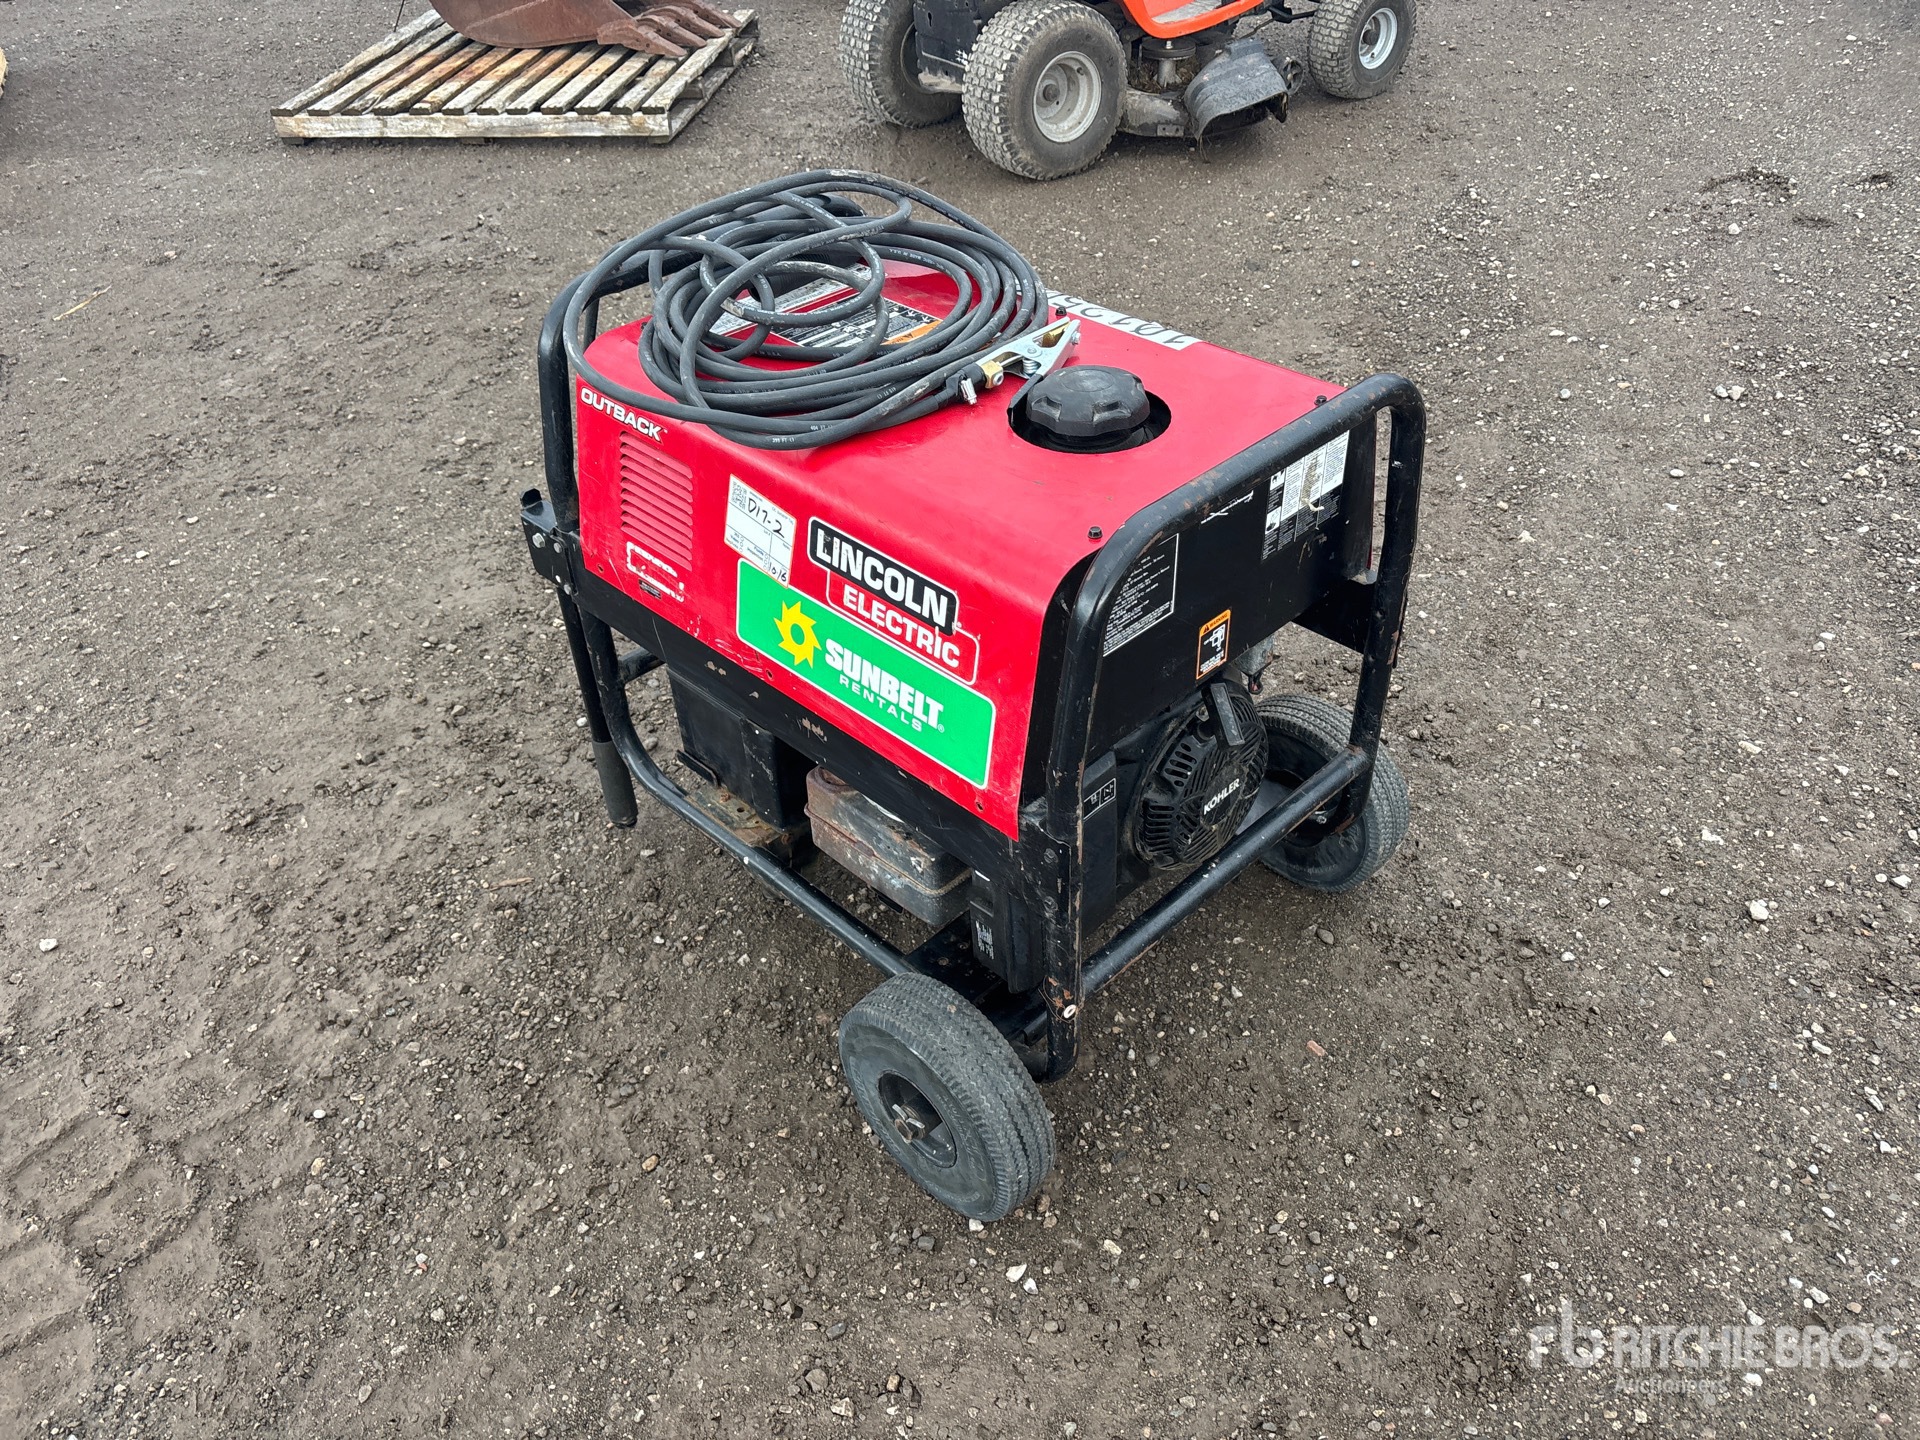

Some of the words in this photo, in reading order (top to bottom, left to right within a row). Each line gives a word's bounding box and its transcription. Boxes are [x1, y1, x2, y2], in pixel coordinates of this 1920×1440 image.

[580, 387, 662, 441] OUTBACK
[747, 498, 785, 539] D17-2
[816, 528, 949, 628] LINCOLN
[843, 583, 961, 668] ELECTRIC
[1209, 612, 1228, 628] WARNING
[825, 638, 944, 730] SUNBELT
[839, 676, 922, 733] RENTALS
[1203, 778, 1240, 816] KOHLER
